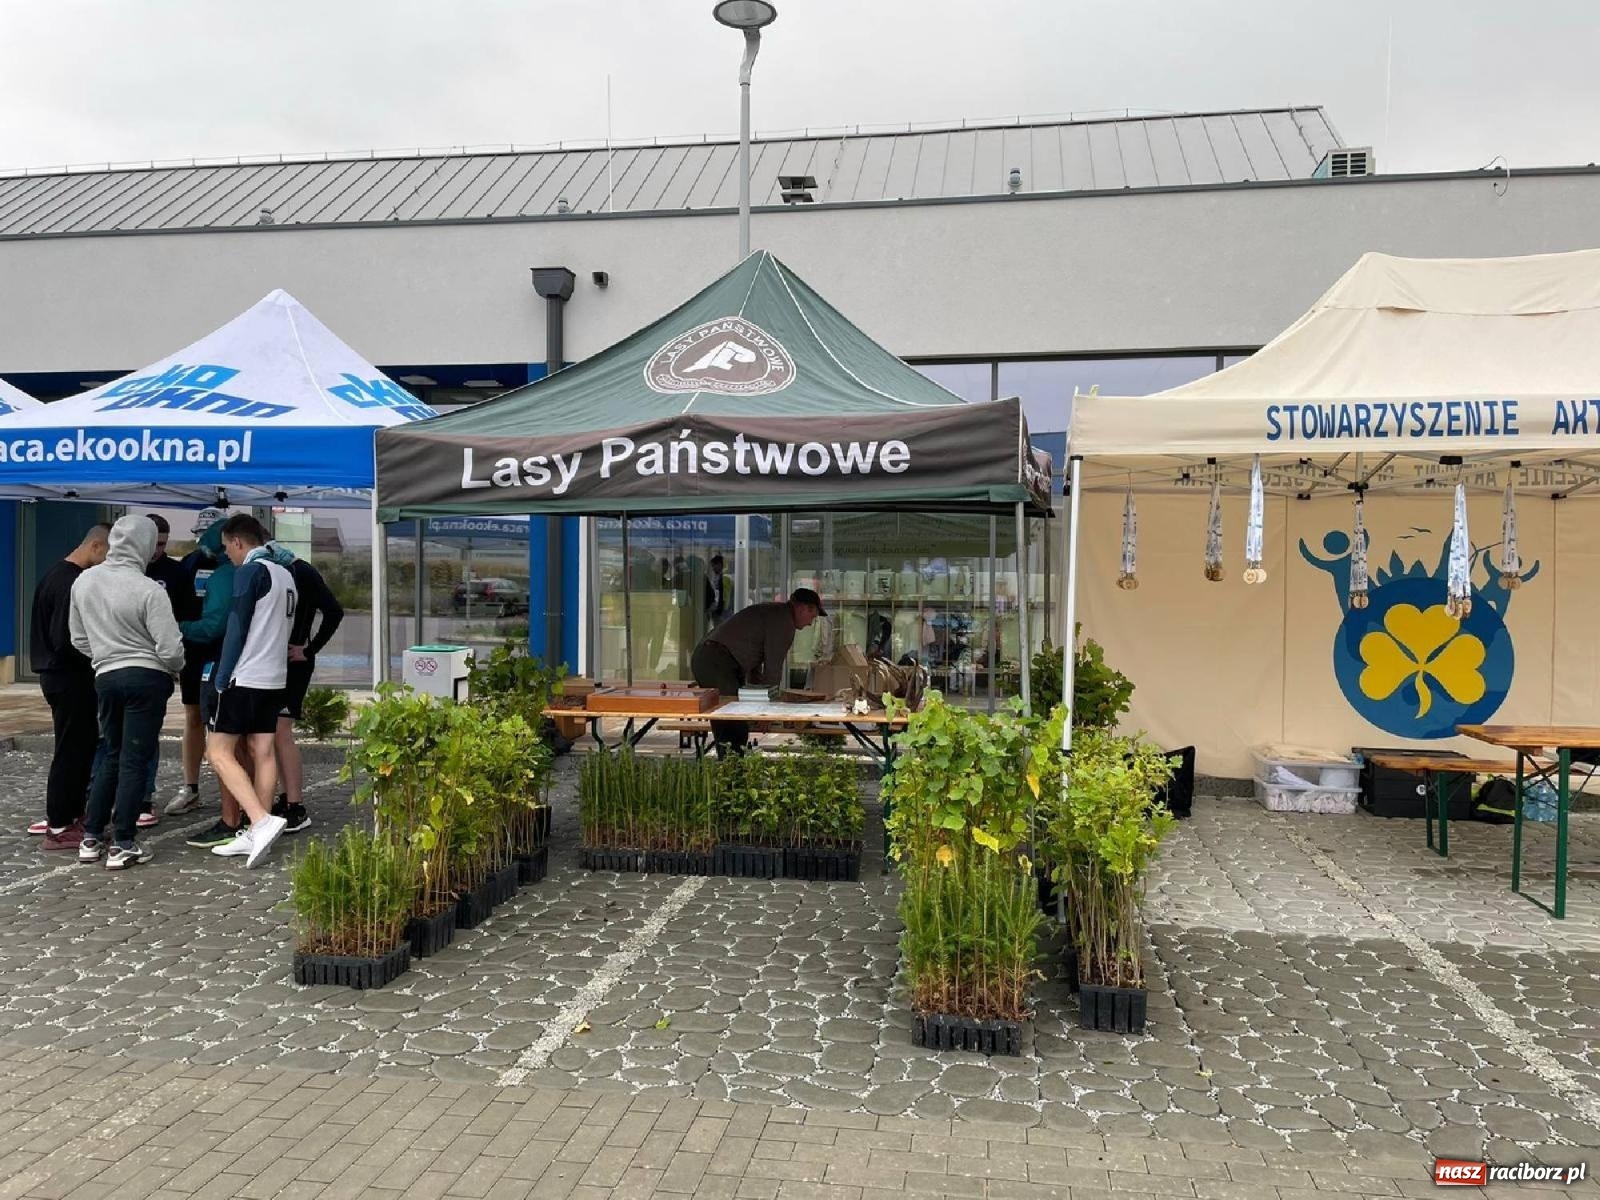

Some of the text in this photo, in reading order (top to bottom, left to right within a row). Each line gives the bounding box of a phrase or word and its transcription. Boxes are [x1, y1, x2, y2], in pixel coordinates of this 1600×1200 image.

[660, 336, 694, 363] LASY
[326, 373, 424, 408] ek
[1266, 399, 1600, 440] STOWARZYSZENIE AKT
[461, 429, 911, 495] Lasy Państwowe
